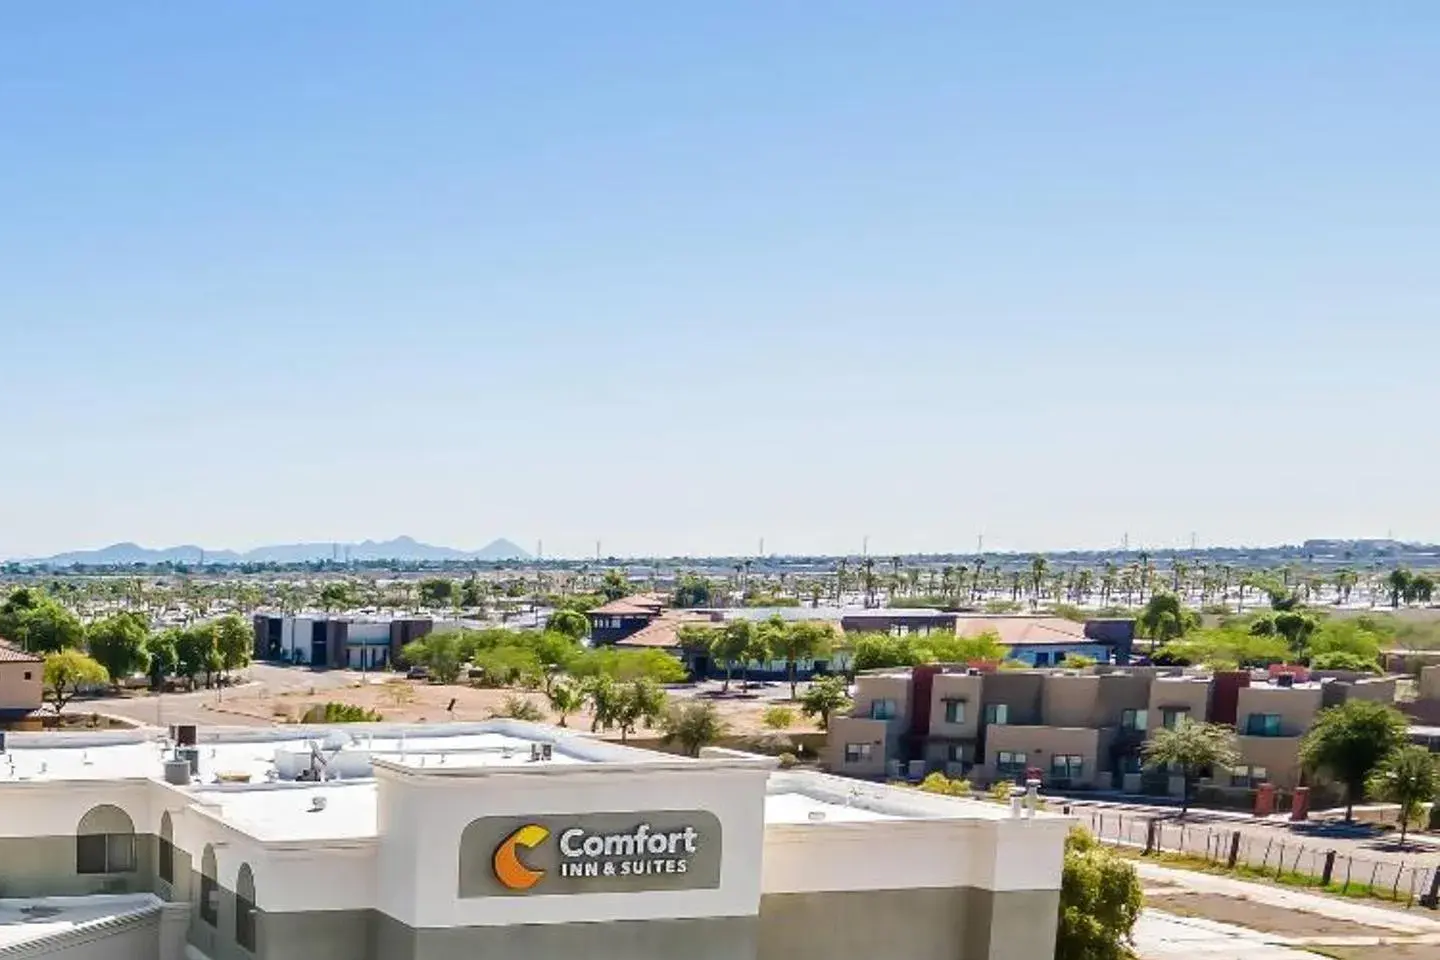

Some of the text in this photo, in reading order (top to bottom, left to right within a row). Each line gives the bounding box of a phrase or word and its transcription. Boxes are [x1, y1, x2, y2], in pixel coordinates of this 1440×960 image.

[560, 824, 697, 857] Comfort
[561, 859, 687, 876] INN & SUITES
